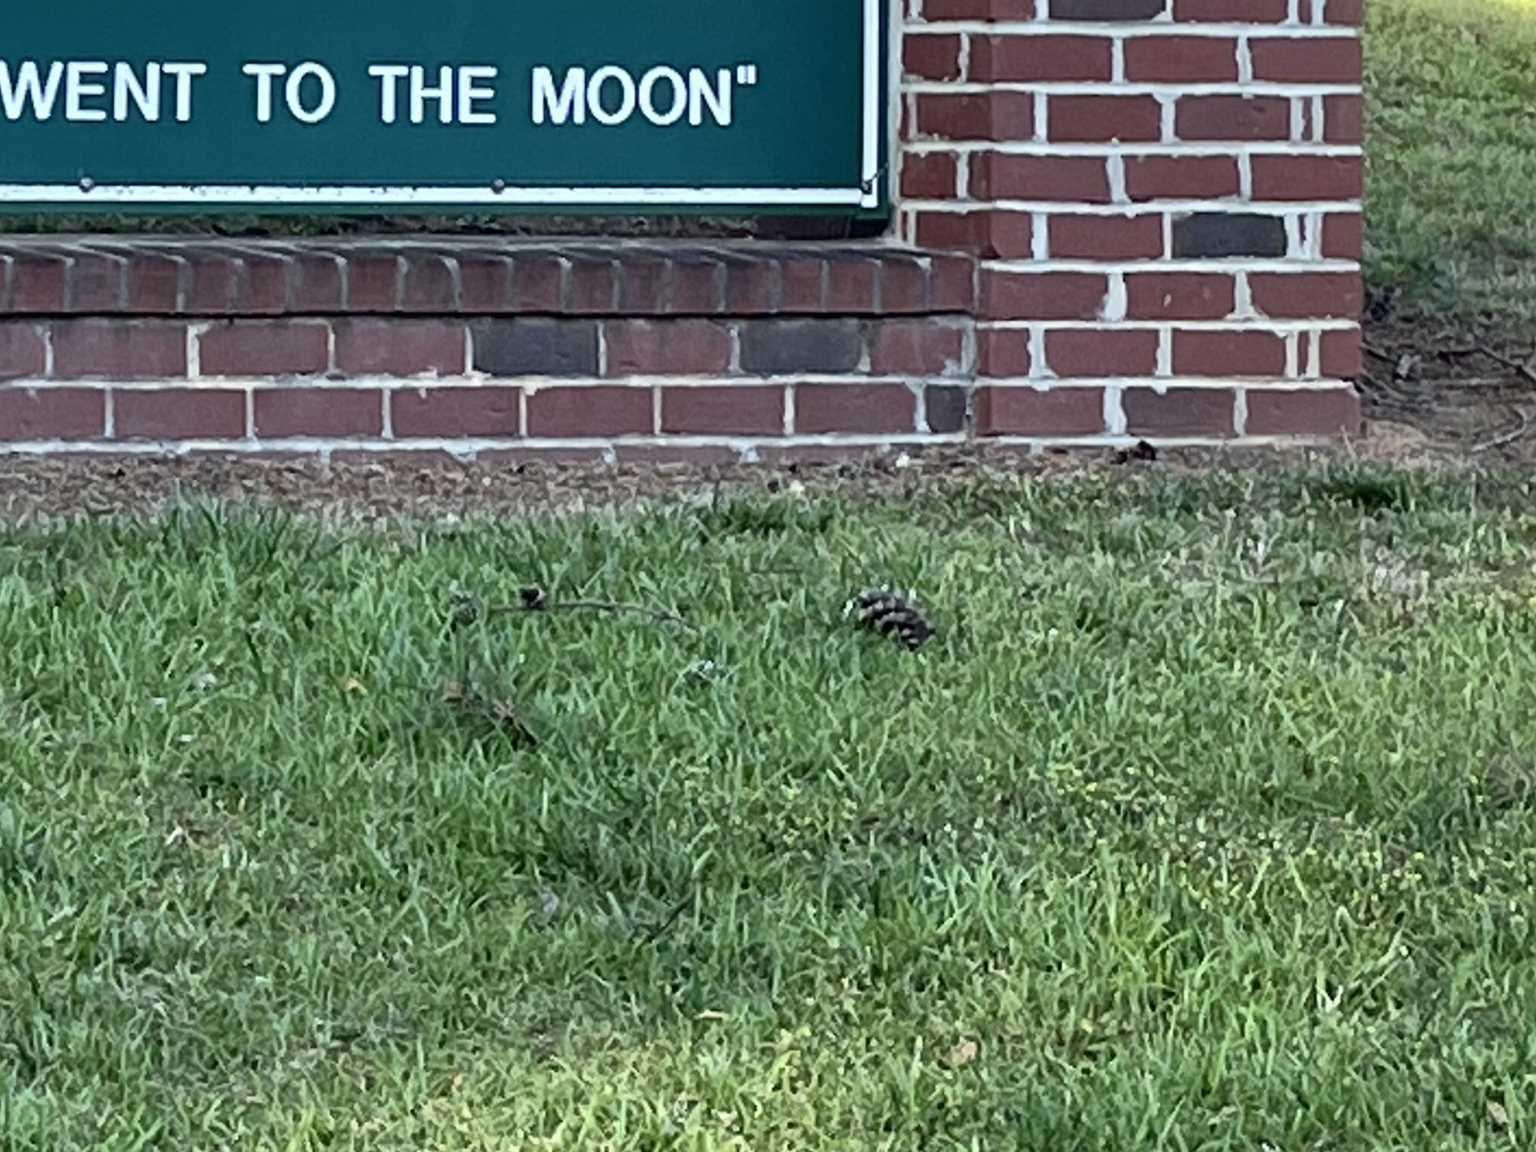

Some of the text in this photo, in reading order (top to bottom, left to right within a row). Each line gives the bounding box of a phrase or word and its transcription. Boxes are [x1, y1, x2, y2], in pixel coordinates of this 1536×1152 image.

[242, 61, 337, 125] TO
[368, 65, 498, 127] THE
[531, 65, 757, 129] MOON"
